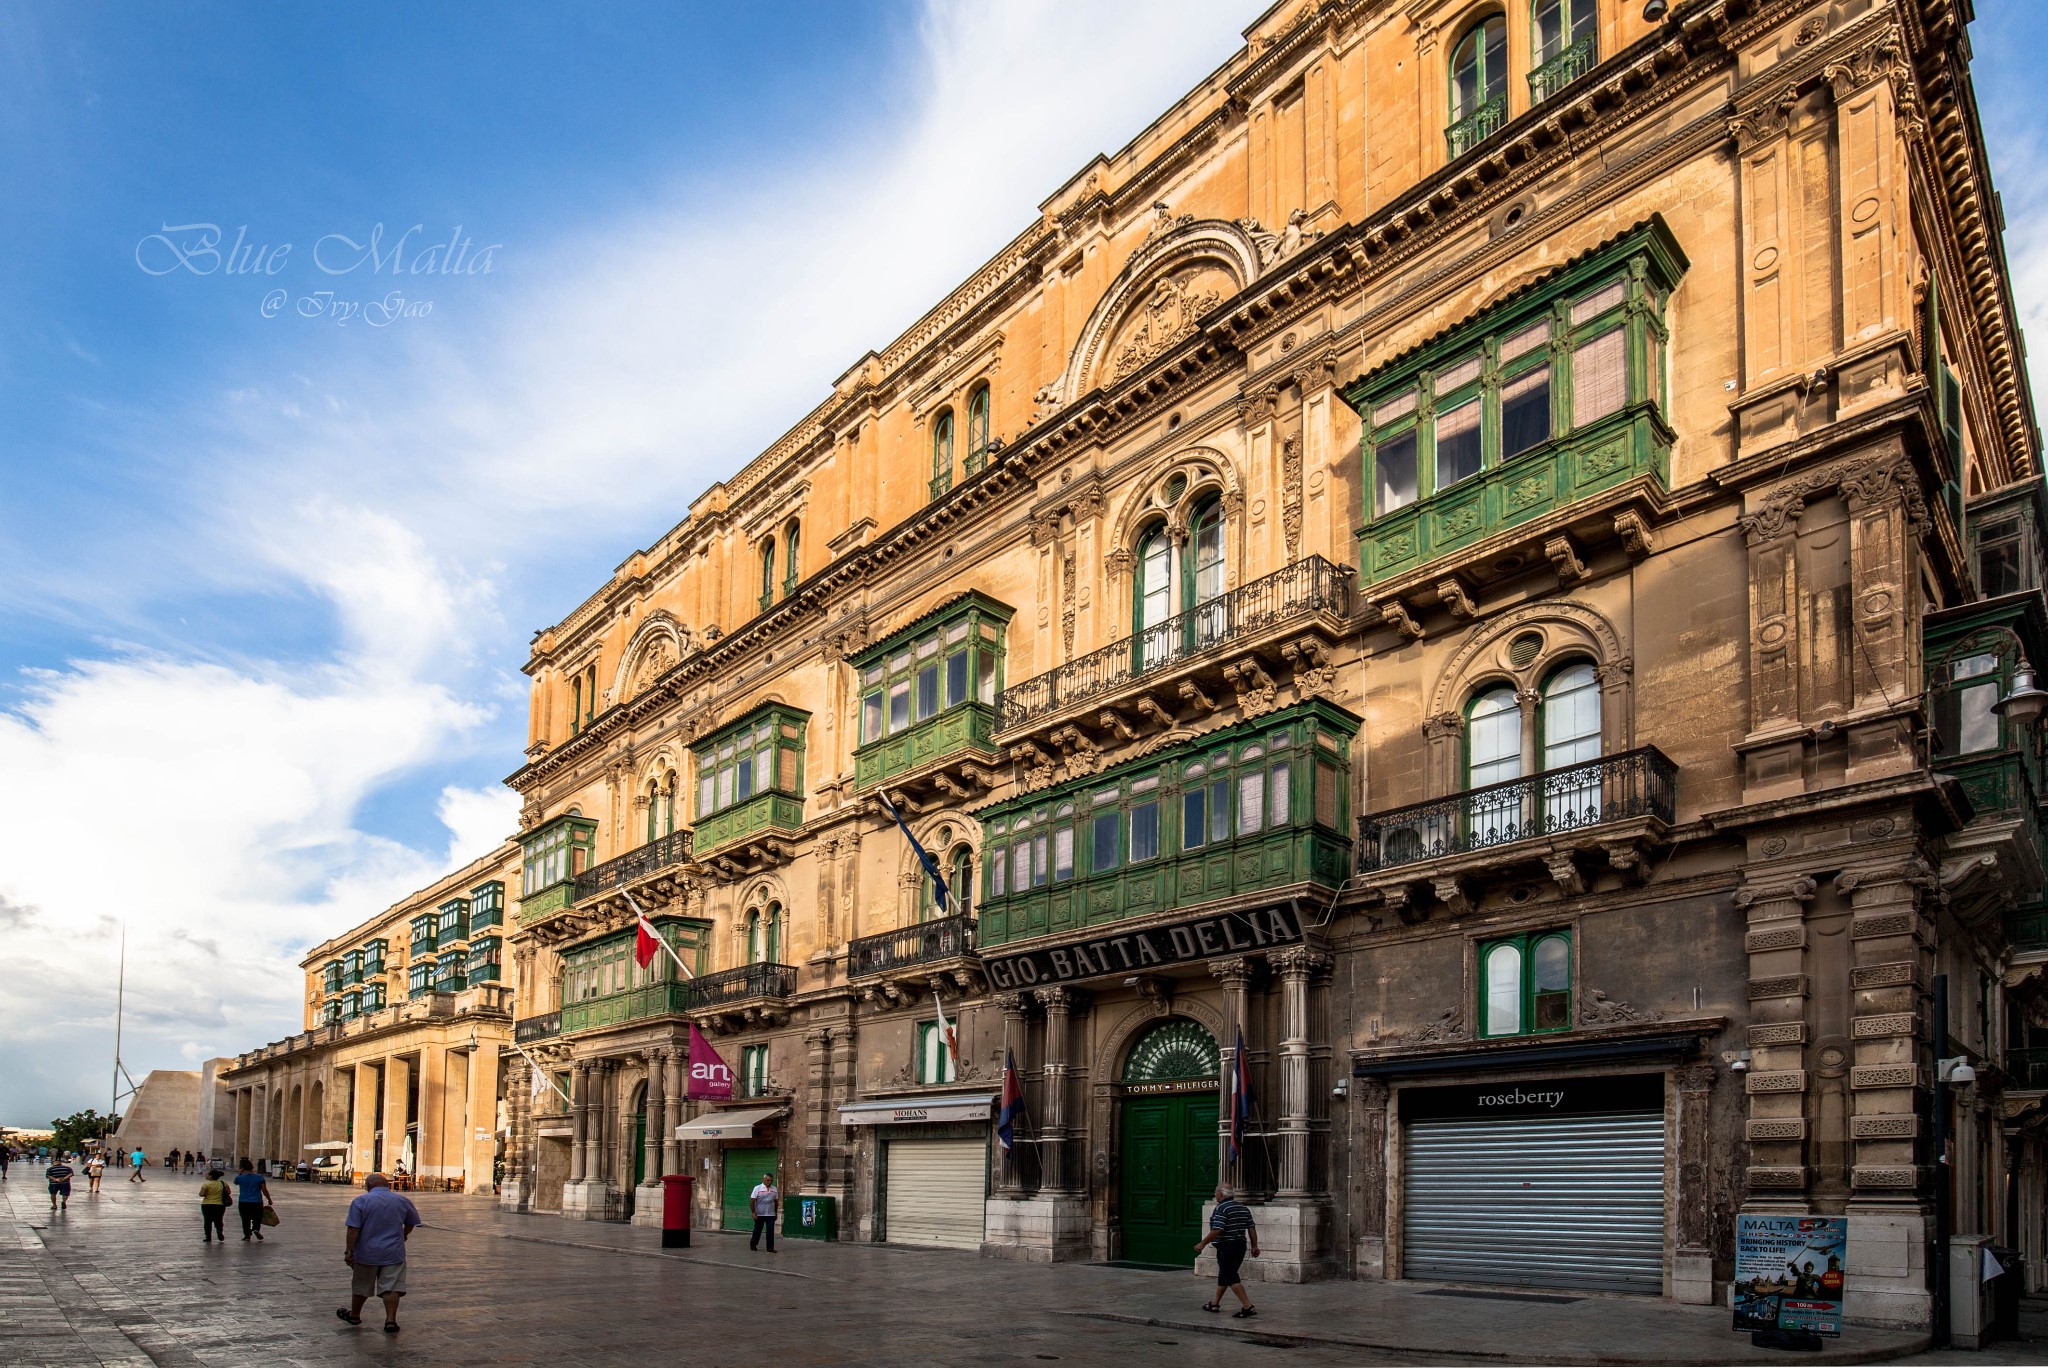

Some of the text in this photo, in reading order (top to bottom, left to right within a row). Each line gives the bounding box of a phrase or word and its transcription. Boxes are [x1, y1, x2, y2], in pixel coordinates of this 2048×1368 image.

[991, 908, 1297, 988] GIO. BATTA DELIA
[691, 1062, 731, 1081] art
[709, 1081, 731, 1089] gallery
[1127, 1080, 1220, 1093] TOMMY HILFIGER
[1477, 1088, 1564, 1108] roseberry
[894, 1109, 928, 1117] MOHANS
[1743, 1220, 1795, 1231] MALTA
[1740, 1238, 1806, 1247] BRINGING HISTORY
